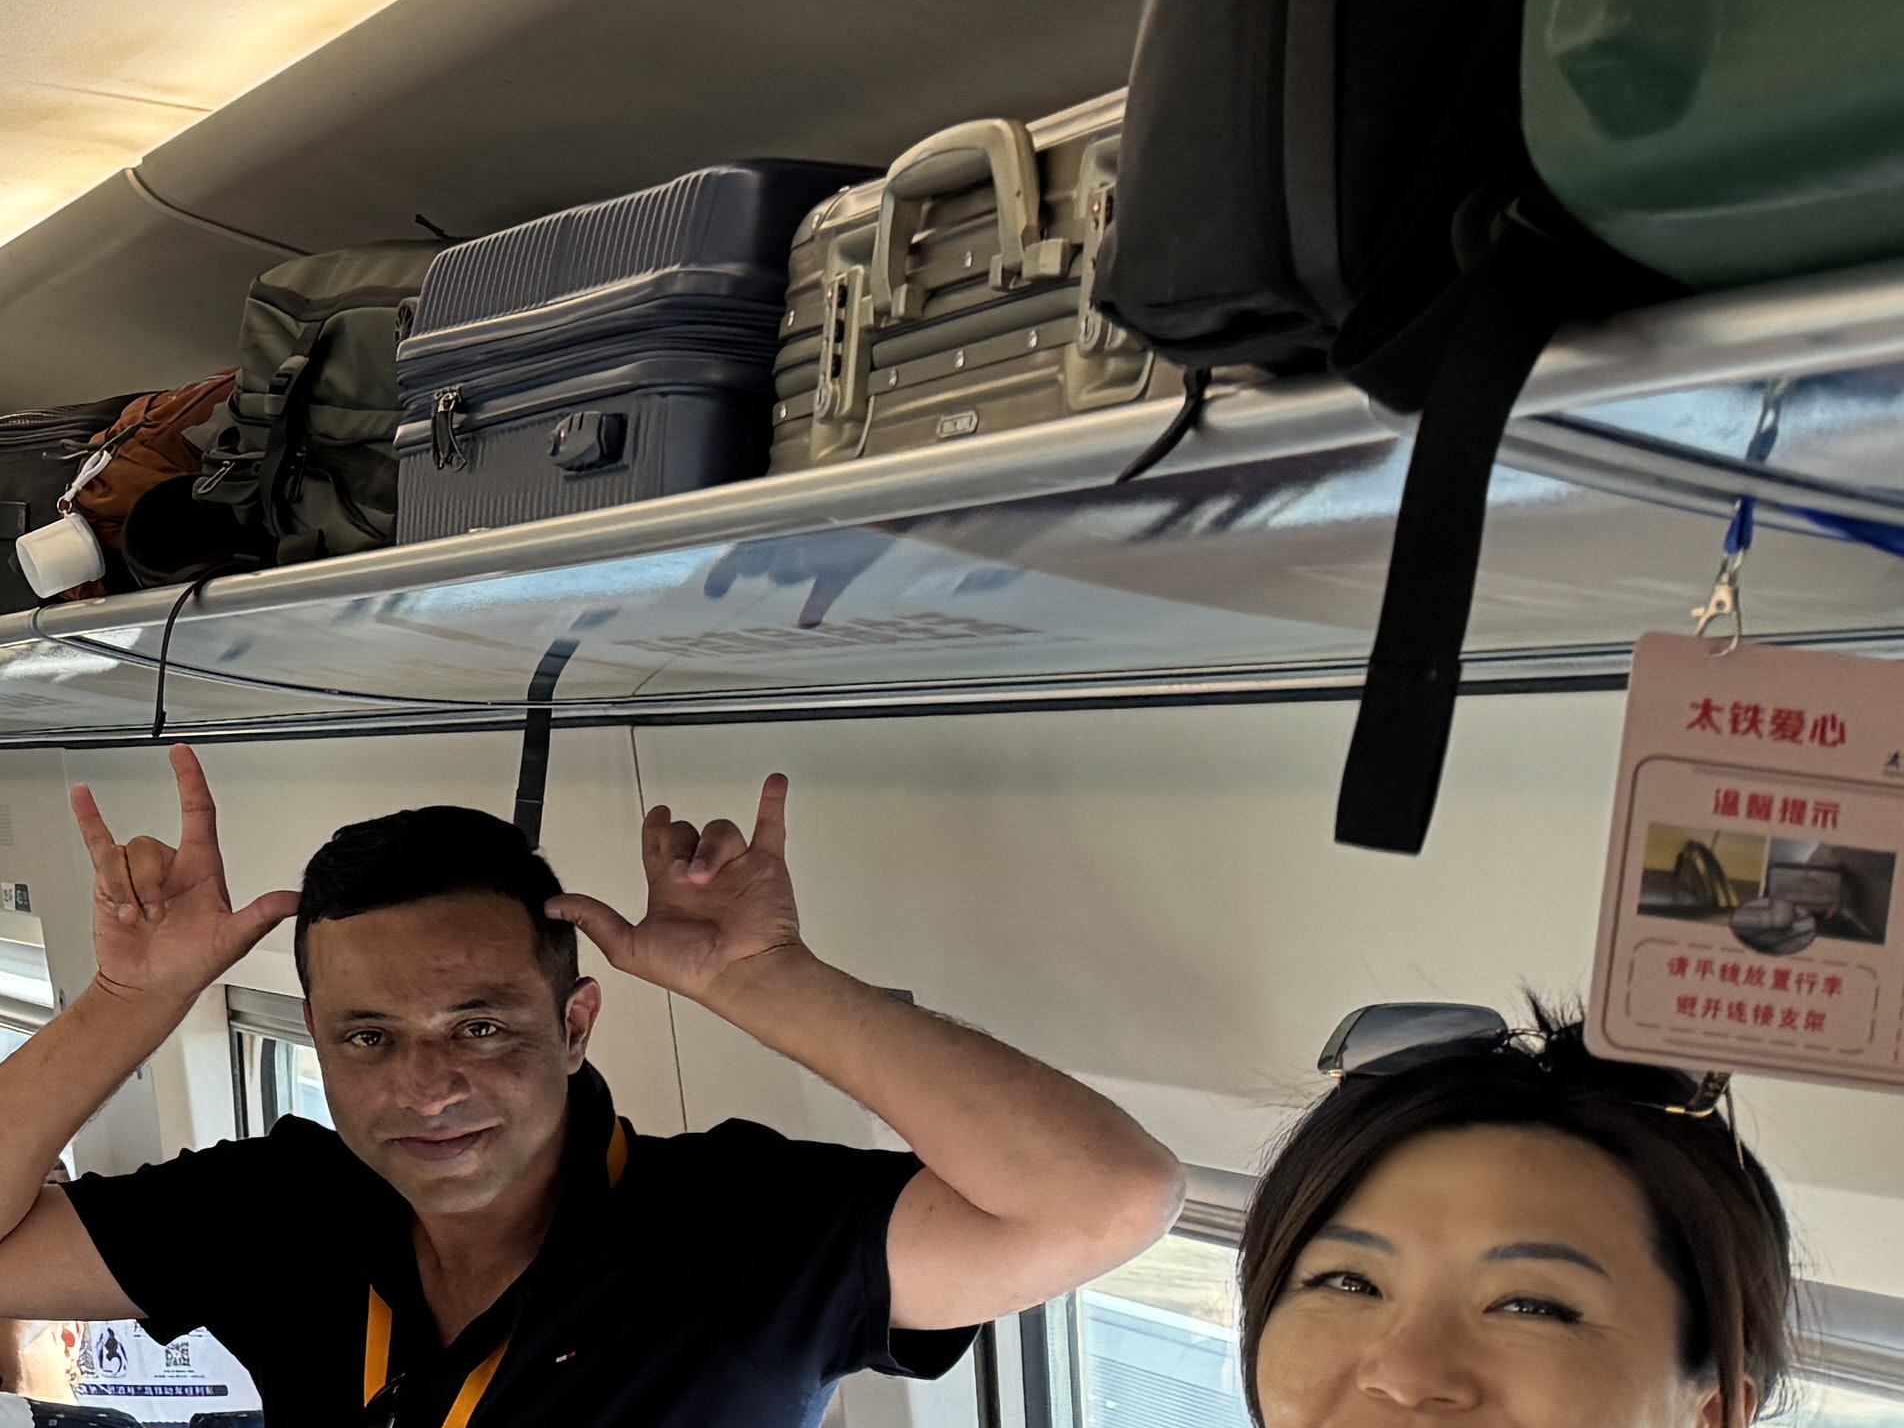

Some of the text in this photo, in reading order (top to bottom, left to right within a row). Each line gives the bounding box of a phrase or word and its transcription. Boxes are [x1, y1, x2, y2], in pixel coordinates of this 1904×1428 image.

[1686, 698, 1848, 748] 太铁爱心
[1713, 786, 1842, 829] 温馨提示
